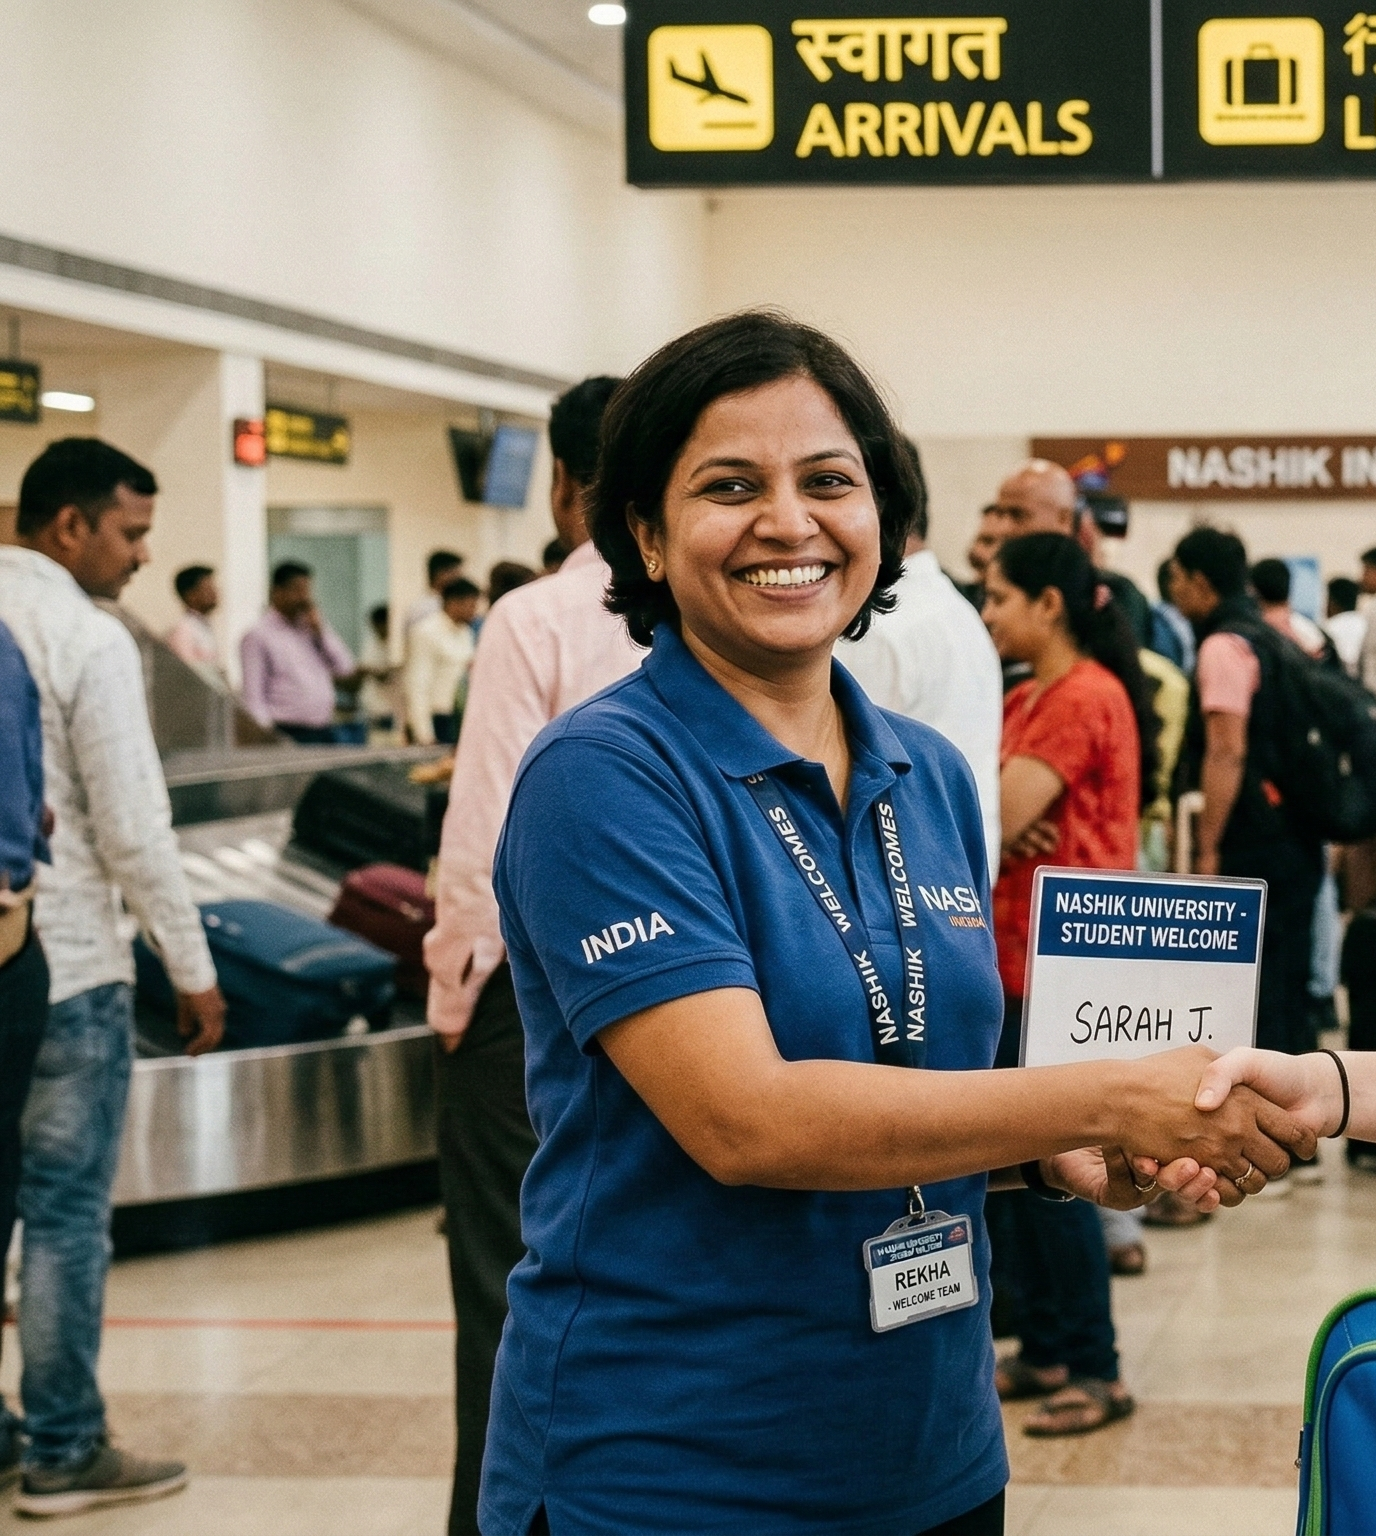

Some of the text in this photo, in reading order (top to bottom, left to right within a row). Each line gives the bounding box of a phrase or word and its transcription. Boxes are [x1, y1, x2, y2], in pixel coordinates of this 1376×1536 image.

[792, 17, 1007, 82] स्वागत
[796, 100, 1093, 158] ARRIVALS
[1167, 445, 1334, 489] NASHIK
[768, 806, 900, 1045] NASHIK WELCOMES
[878, 802, 926, 1042] NASHIK WELCOMES
[1055, 892, 1127, 916] NASHIK
[1130, 896, 1236, 922] UNIVERSITY
[580, 911, 675, 964] INDIA
[1060, 922, 1239, 950] STUDENT WELCOME
[1070, 1000, 1213, 1044] SARAH J.
[895, 1260, 951, 1291] REKHA
[893, 1289, 935, 1310] WELCOME
